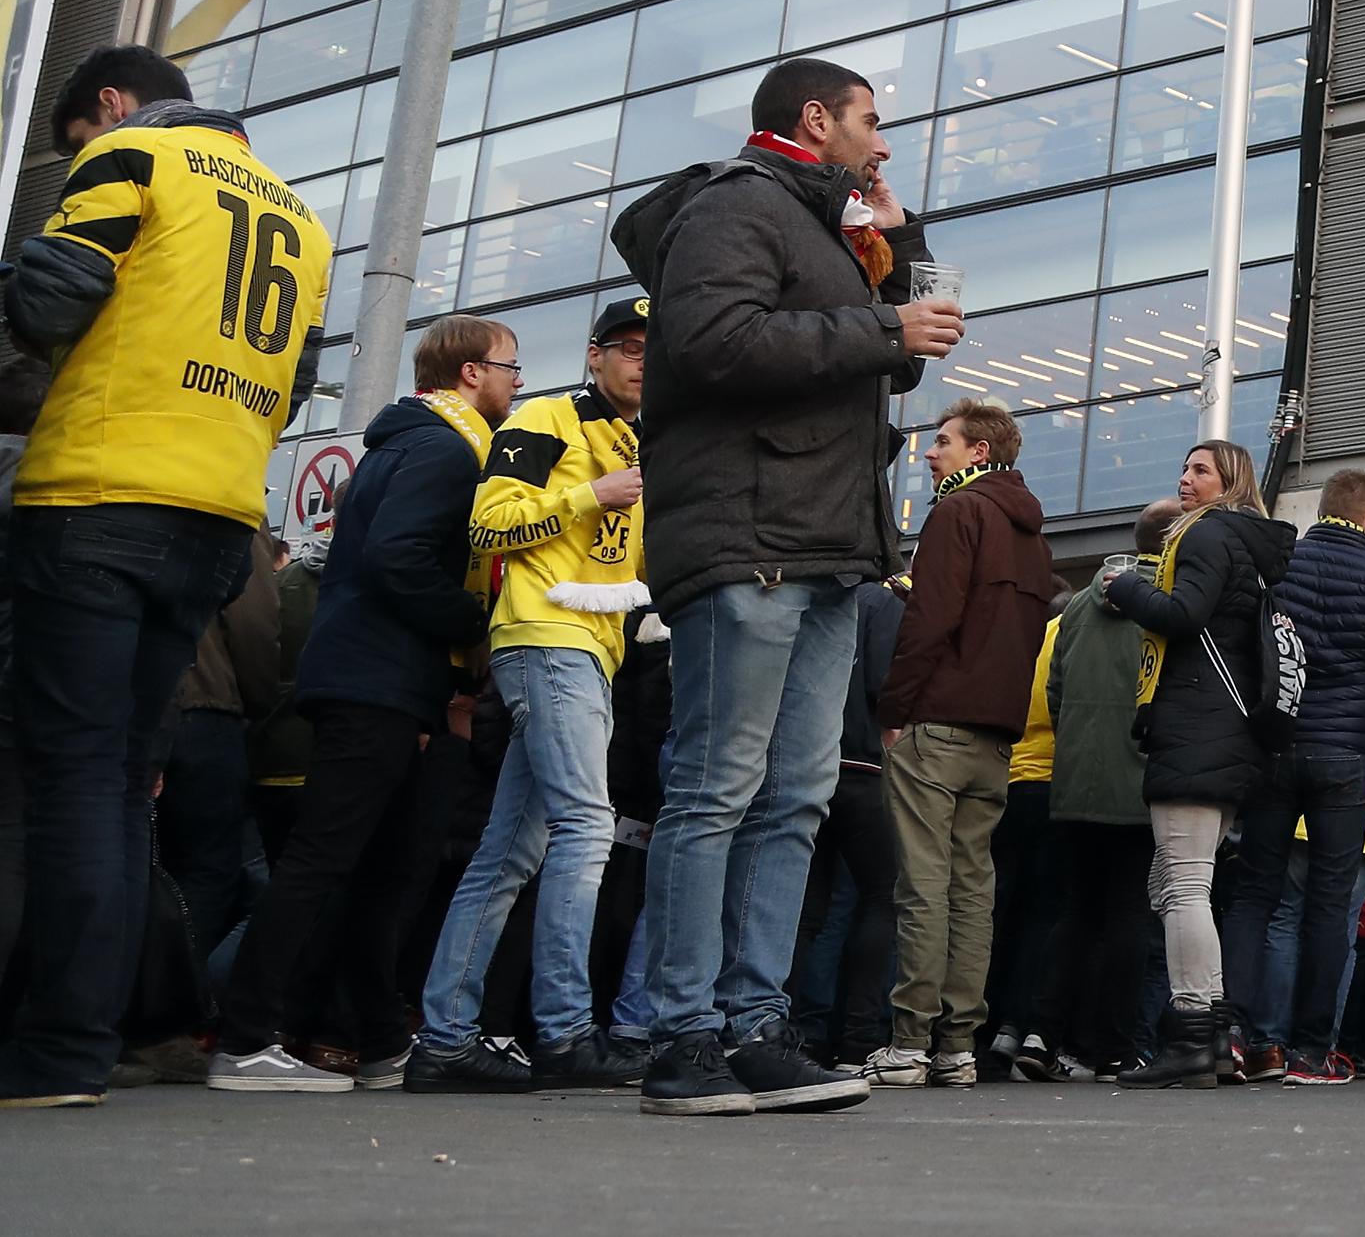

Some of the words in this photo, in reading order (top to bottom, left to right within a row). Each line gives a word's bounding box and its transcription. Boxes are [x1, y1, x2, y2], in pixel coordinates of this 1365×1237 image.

[217, 189, 301, 355] 16
[181, 359, 281, 417] DORTMUND
[601, 546, 617, 559] 09
[1140, 643, 1154, 678] VB
